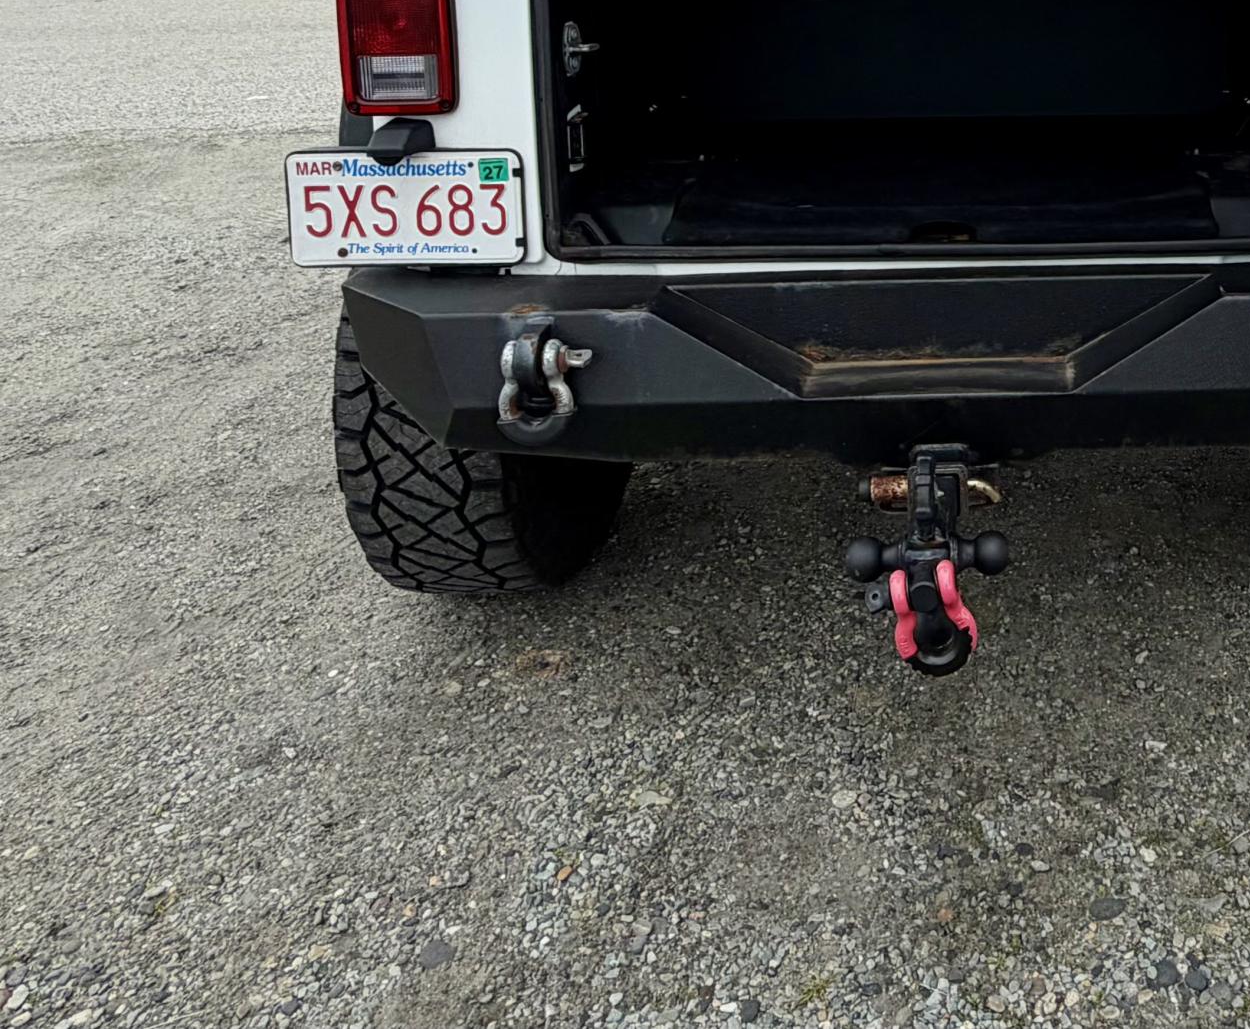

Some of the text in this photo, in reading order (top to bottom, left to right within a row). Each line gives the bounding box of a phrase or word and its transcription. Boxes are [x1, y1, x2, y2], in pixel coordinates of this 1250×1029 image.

[296, 161, 332, 176] MAR
[341, 157, 467, 177] Massachusetts
[483, 165, 503, 180] 27
[303, 183, 507, 238] 5XS 683
[348, 242, 469, 255] The Spirit of America
